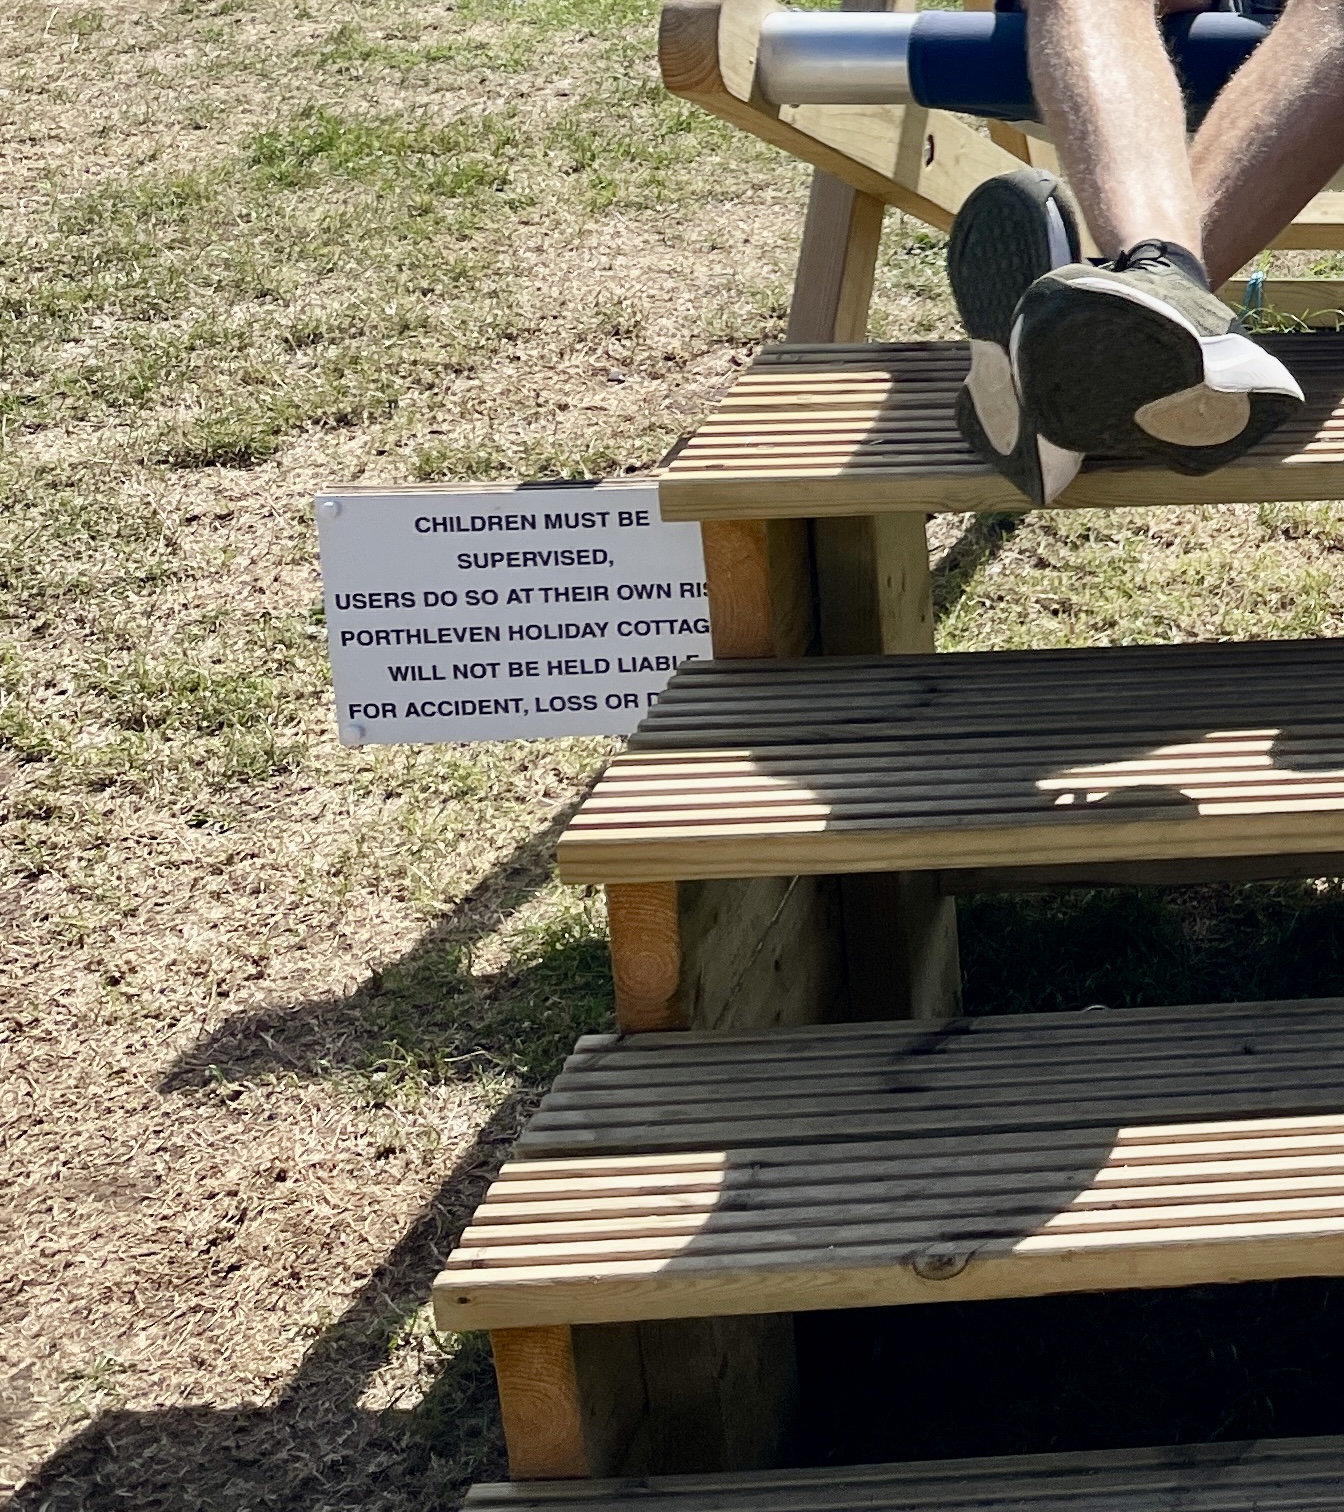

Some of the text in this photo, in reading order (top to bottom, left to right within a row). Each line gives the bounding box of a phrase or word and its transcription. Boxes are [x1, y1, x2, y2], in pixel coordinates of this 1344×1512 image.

[414, 510, 651, 534] CHILDREN MUST BE
[457, 548, 614, 570] SUPERVISED,
[335, 591, 416, 610] USERS
[423, 590, 458, 608] DO
[465, 589, 499, 606] SO
[506, 587, 535, 605] AT
[537, 584, 610, 604] THEIR
[616, 583, 672, 601] OWN
[340, 618, 710, 647] PORTHLEVEN HOLIDAY COTTAG
[387, 664, 447, 682] WILL
[452, 662, 501, 680] NOT
[507, 660, 541, 678] BE
[547, 657, 611, 676] HELD
[348, 702, 397, 720] FOR
[404, 697, 529, 719] ACCIDENT,
[534, 694, 598, 713] LOSS
[605, 692, 639, 710] OR
